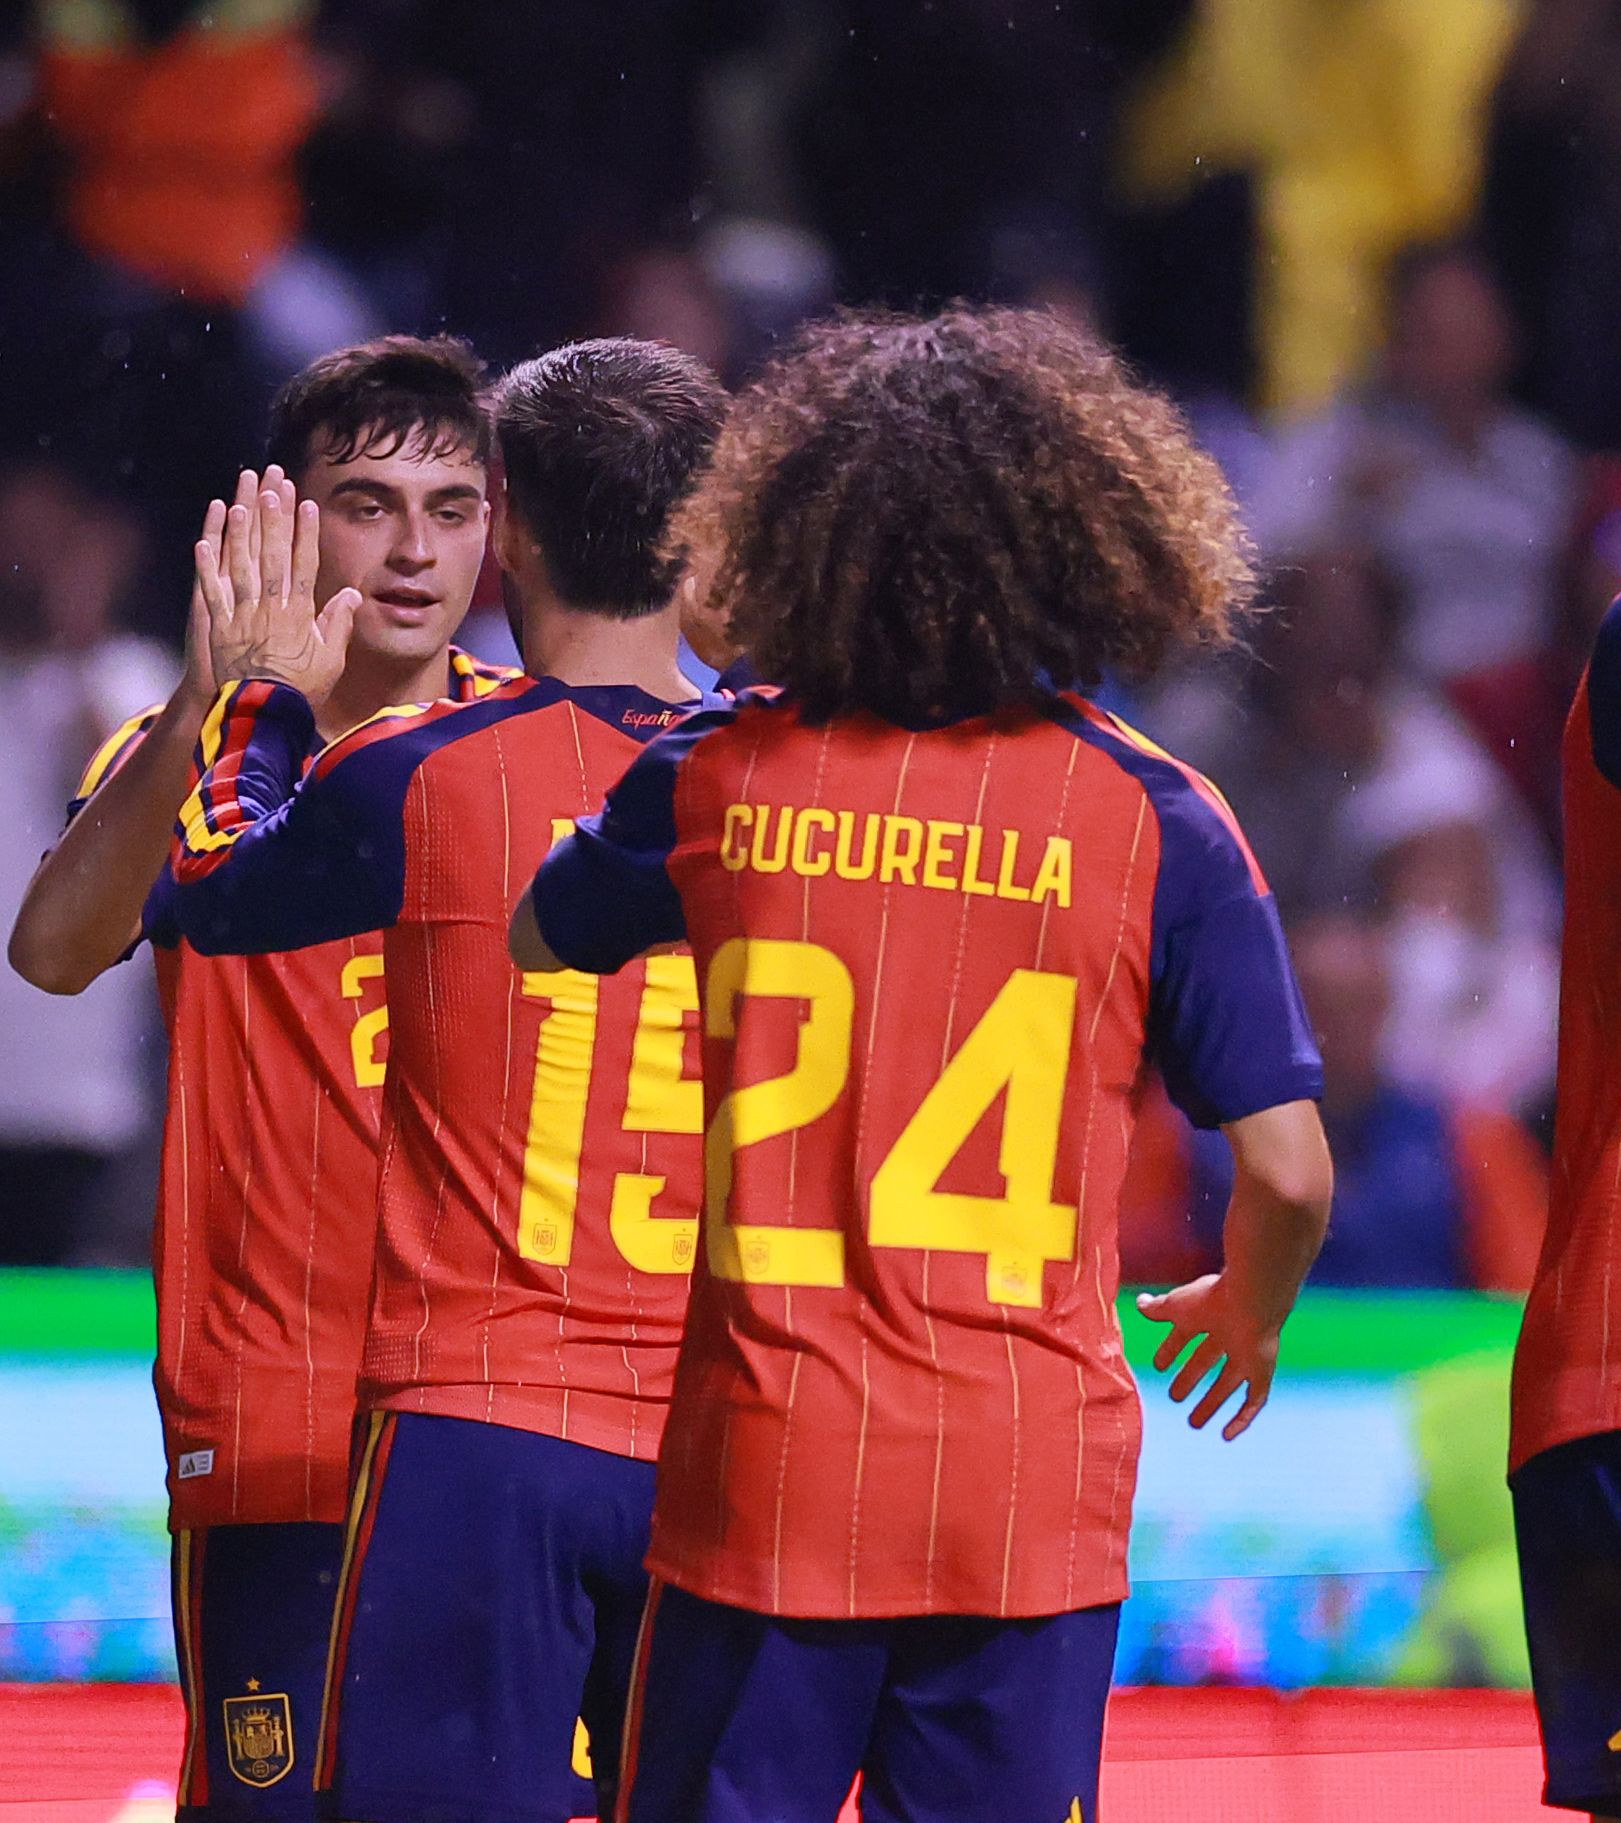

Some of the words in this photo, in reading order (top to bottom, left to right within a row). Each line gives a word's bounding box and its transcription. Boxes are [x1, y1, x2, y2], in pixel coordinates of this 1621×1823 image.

[720, 803, 1073, 908] CUCURELLA
[519, 955, 704, 1274] 15
[706, 938, 1078, 1308] 24
